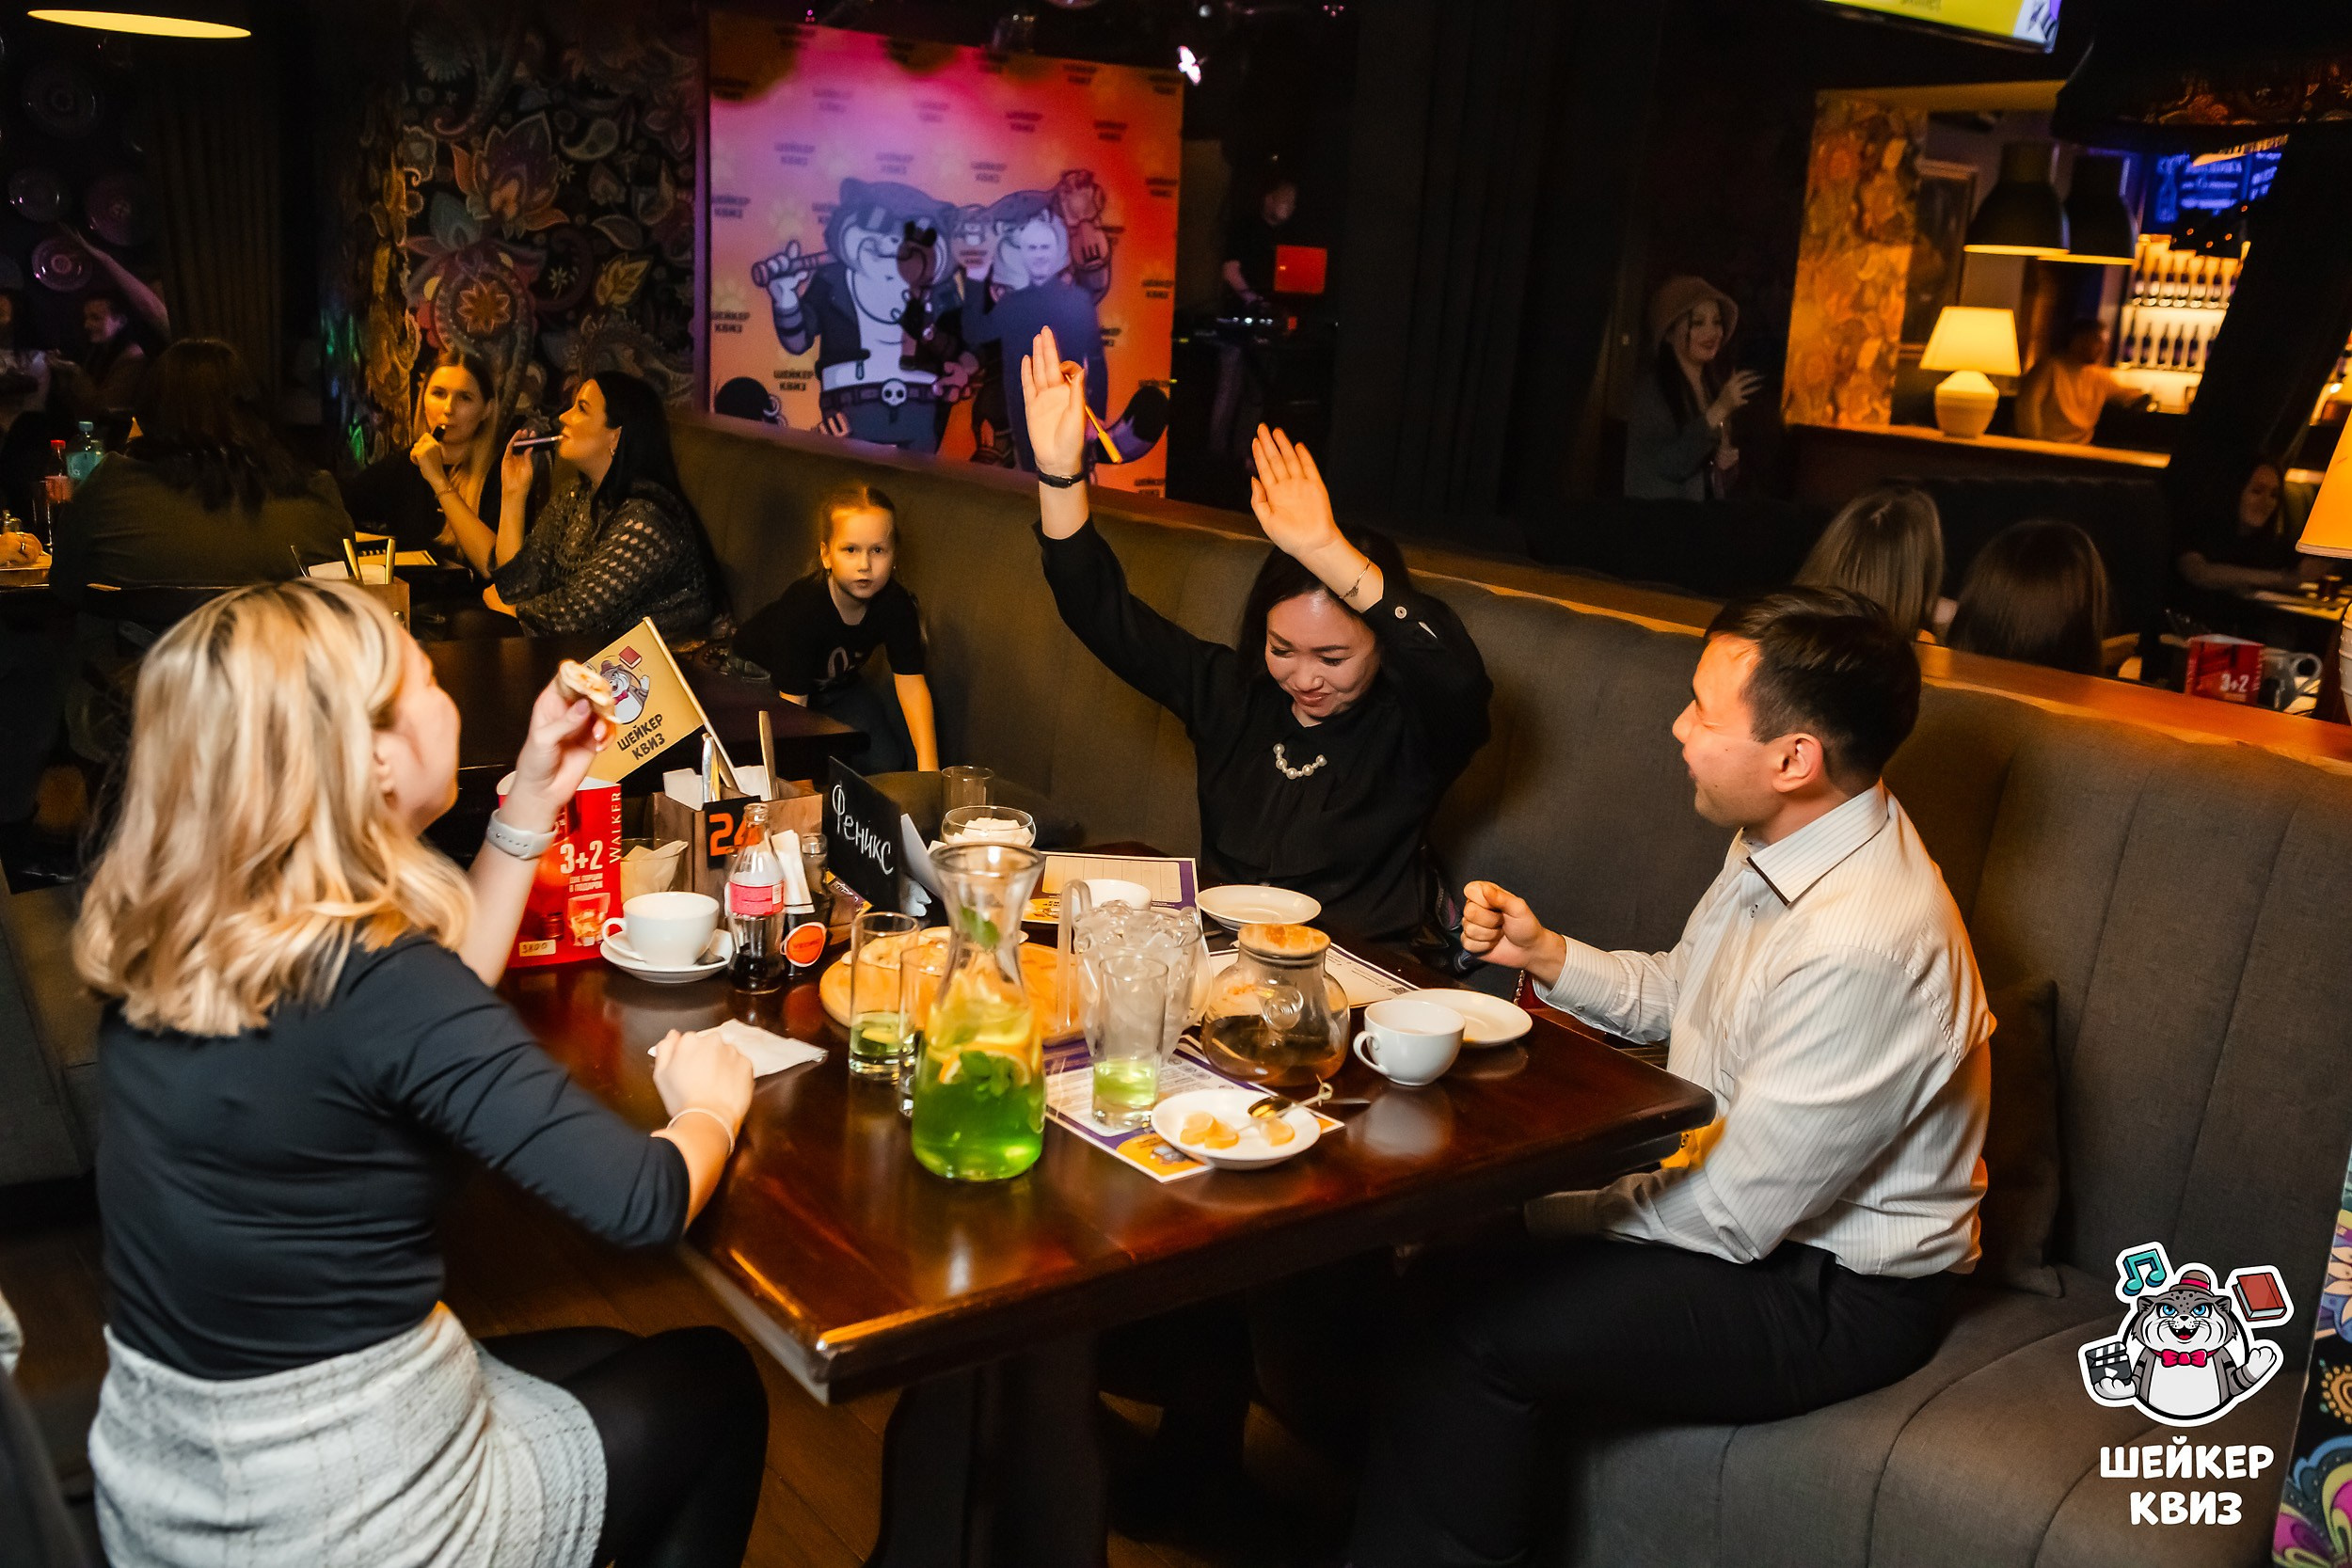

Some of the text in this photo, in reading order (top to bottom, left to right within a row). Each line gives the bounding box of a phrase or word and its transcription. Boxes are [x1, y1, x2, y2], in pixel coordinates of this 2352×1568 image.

[616, 713, 663, 752] ШЕЙКЕР
[631, 732, 666, 761] КВИЗ
[609, 791, 623, 864] WALKER
[832, 781, 894, 876] Феникс
[560, 839, 604, 875] 3+2
